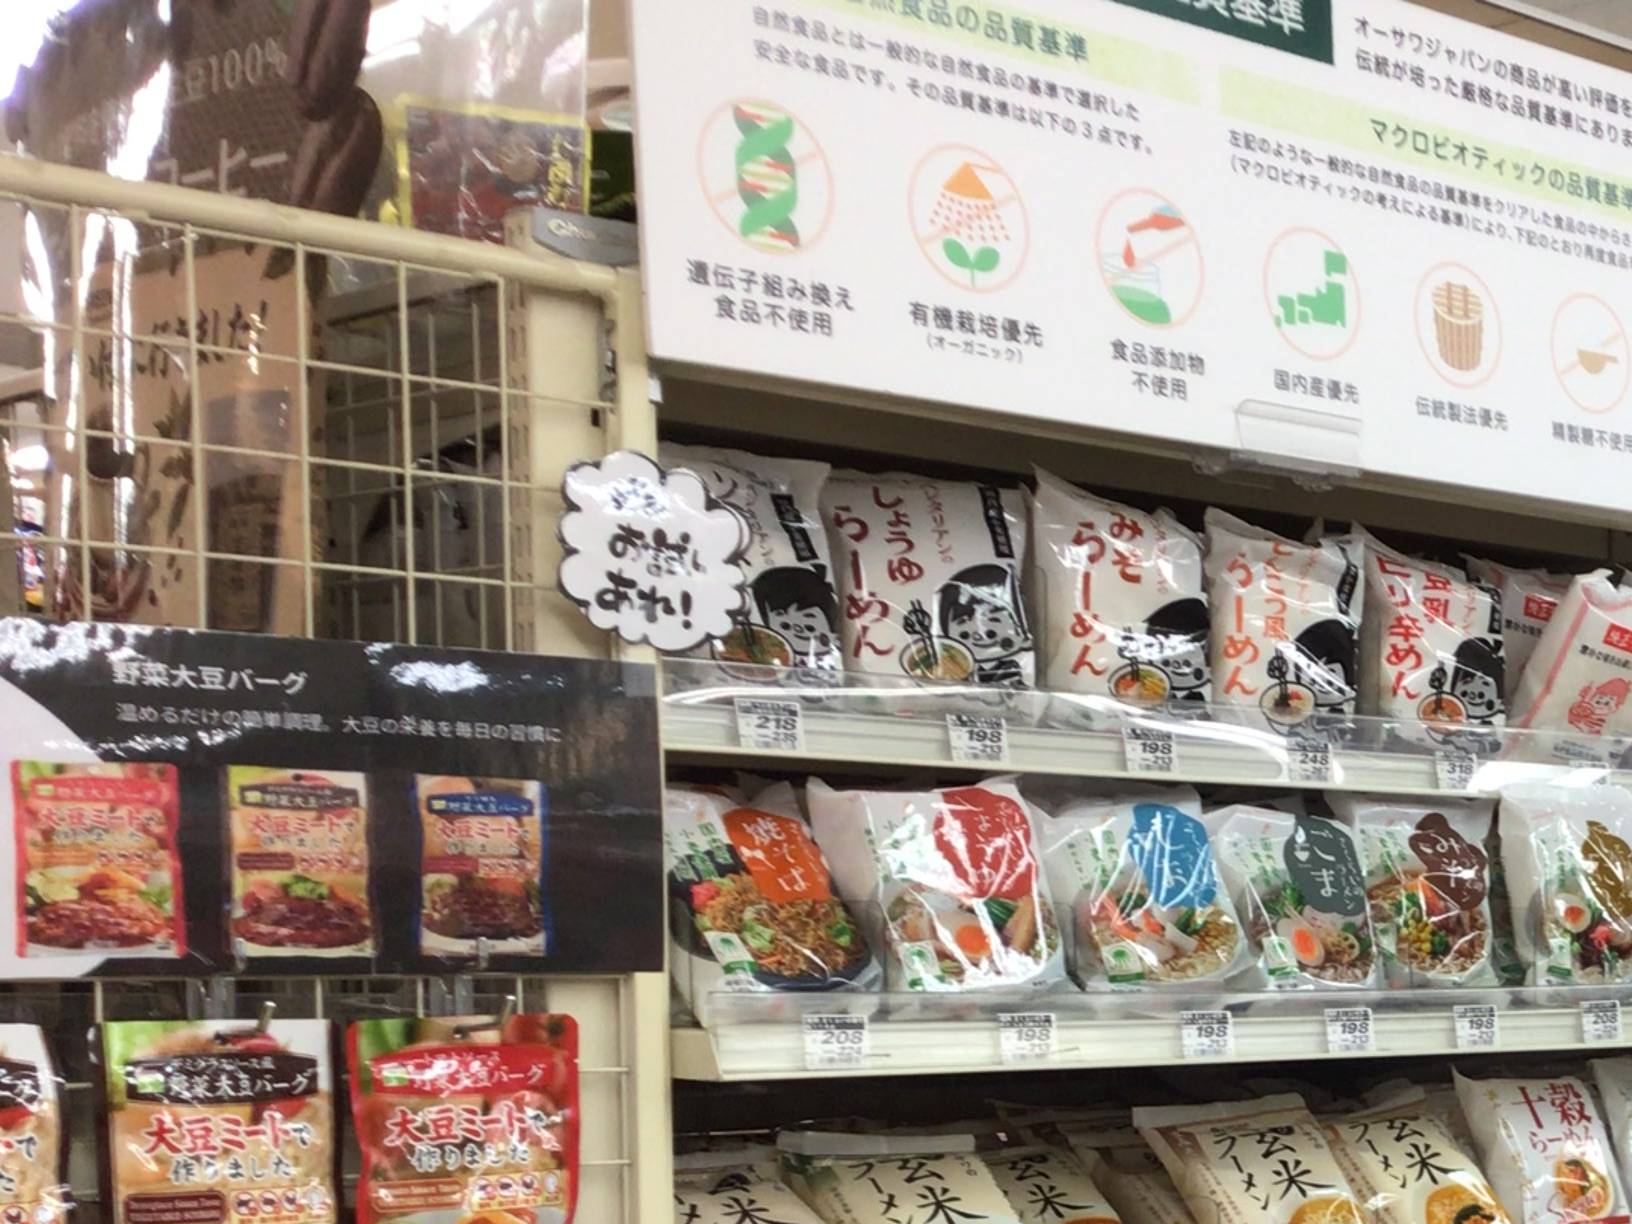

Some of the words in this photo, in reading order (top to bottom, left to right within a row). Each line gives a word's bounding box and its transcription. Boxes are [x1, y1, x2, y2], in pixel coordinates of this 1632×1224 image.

[687, 259, 855, 313] 遺伝子組み換え
[714, 295, 833, 338] 食品不使用
[909, 301, 1044, 348] 有機栽培優先
[1110, 338, 1206, 377] 食品添加物
[1131, 372, 1187, 402] 不使用
[1274, 369, 1359, 404] 国内産優先
[1416, 396, 1508, 432] 伝統製法優先
[872, 486, 925, 586] しょうゆ
[1109, 511, 1143, 584] みそ
[831, 506, 894, 658] らーめん
[1069, 522, 1110, 678] らーめん
[1222, 553, 1260, 697] らーめん
[112, 660, 308, 695] 野菜大豆バーグ
[756, 717, 797, 731] 218
[968, 728, 1001, 743] 198
[1141, 741, 1172, 754] 198
[1300, 753, 1328, 765] 248
[821, 1030, 863, 1045] 208
[1016, 1027, 1049, 1041] 198
[1197, 1026, 1227, 1037] 198
[1341, 1022, 1368, 1033] 198
[1469, 1018, 1494, 1029] 198
[1518, 1081, 1594, 1129] 十穀
[144, 1110, 312, 1155] 大豆ミートで
[1384, 1114, 1465, 1185] 玄米
[1528, 1123, 1596, 1154] らーめん
[1214, 1129, 1272, 1212] ラーメン
[1254, 1125, 1336, 1199] 玄米
[1349, 1119, 1408, 1189] ラーメン
[1012, 1153, 1095, 1219] 玄米
